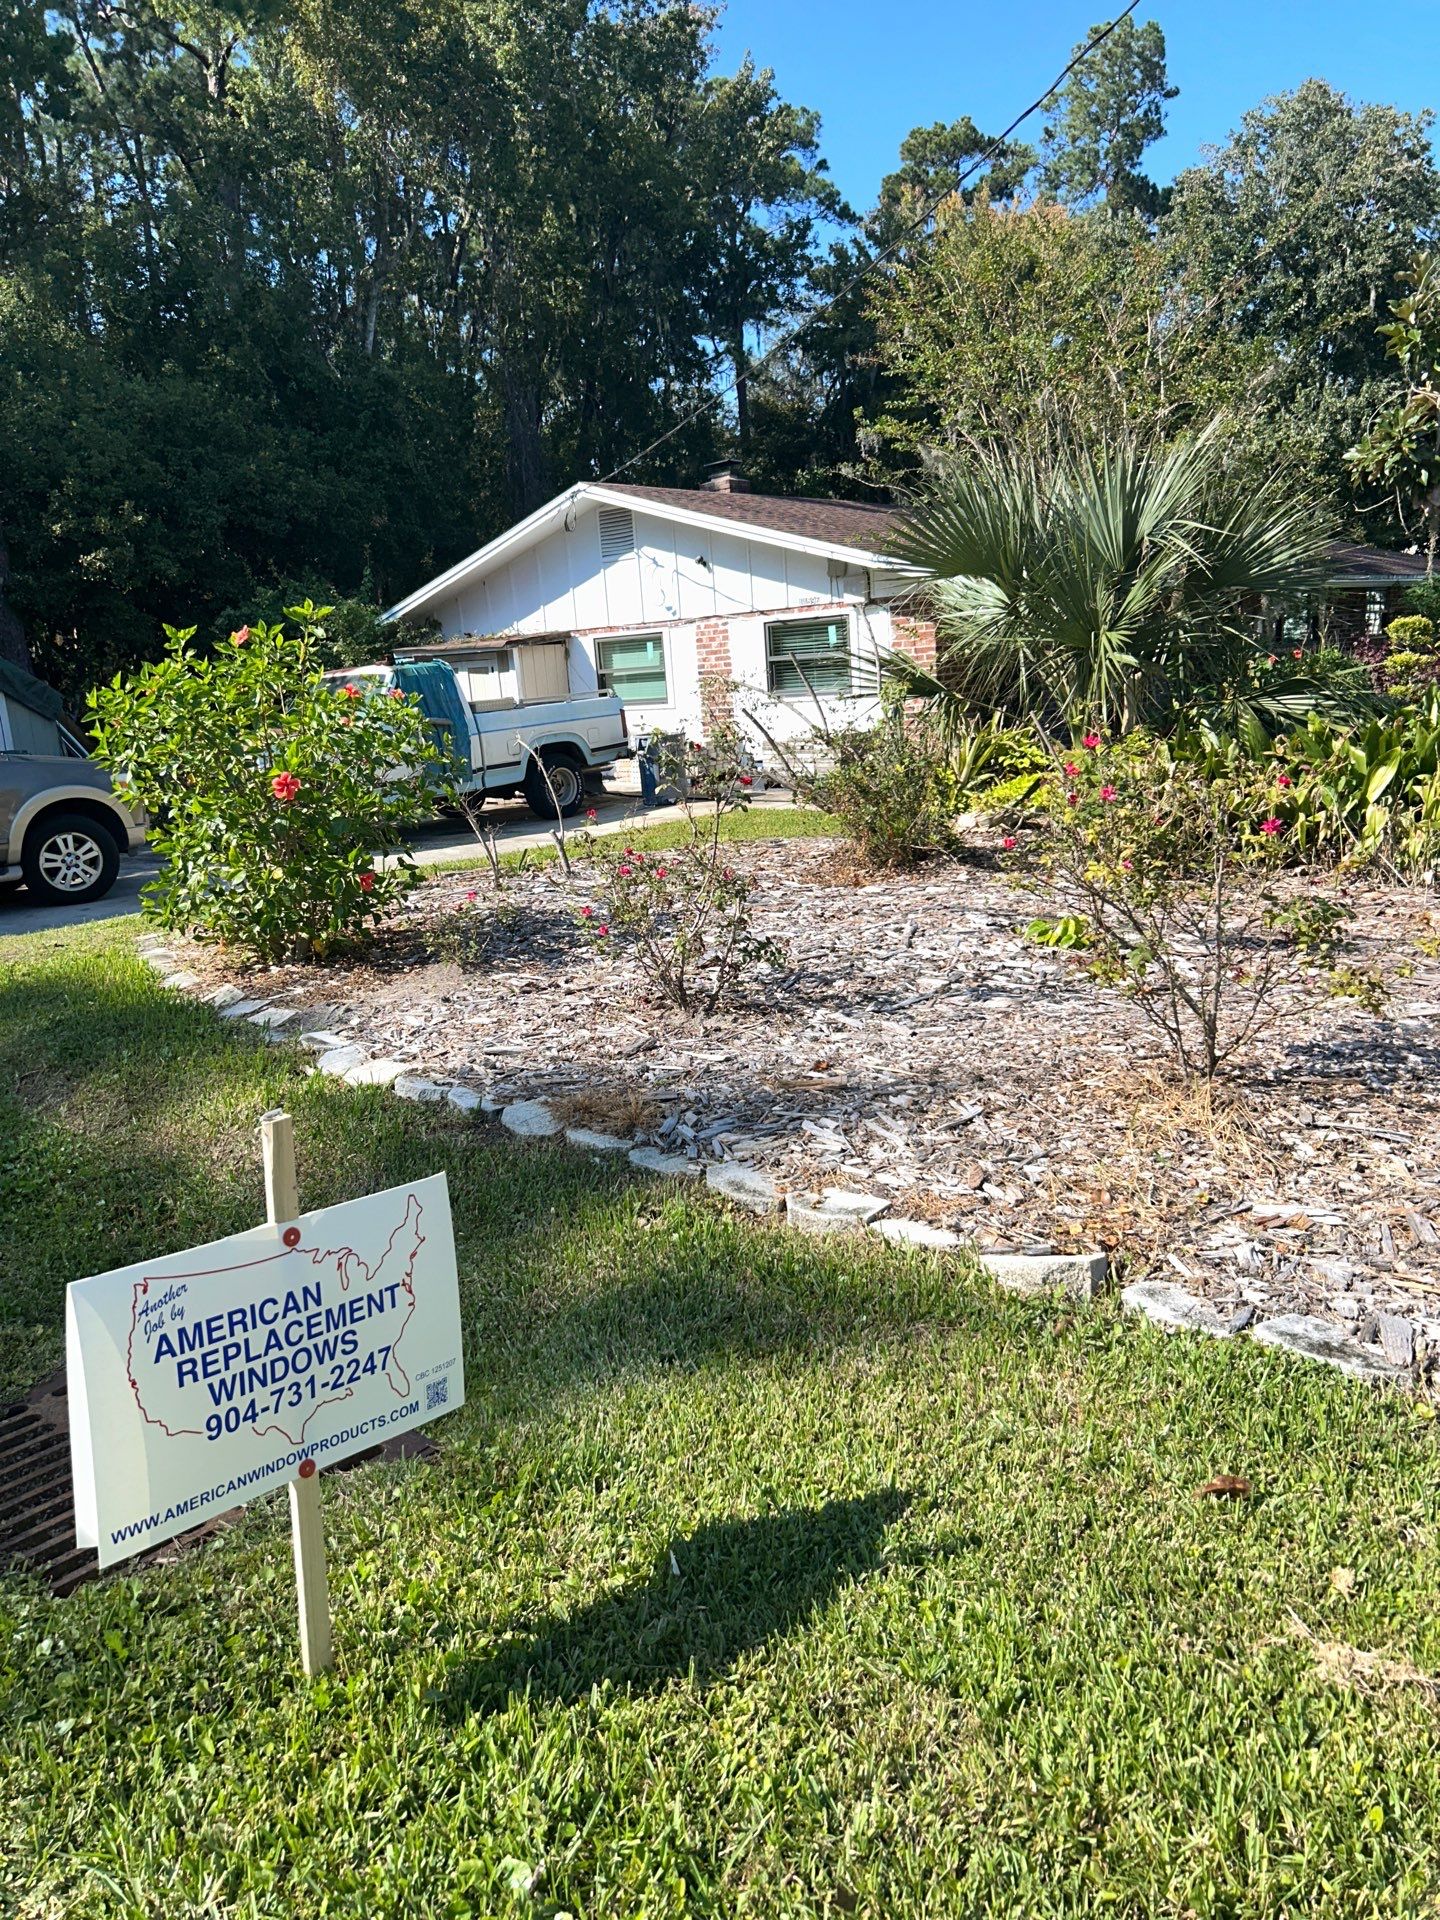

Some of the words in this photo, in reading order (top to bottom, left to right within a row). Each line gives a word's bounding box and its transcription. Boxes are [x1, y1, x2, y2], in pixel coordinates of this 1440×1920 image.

[138, 1282, 188, 1322] Another
[143, 1316, 166, 1343] Job
[170, 1304, 186, 1323] by
[153, 1281, 323, 1364] AMERICAN
[176, 1283, 402, 1388] REPLACEMENT
[205, 1346, 392, 1441] 904-731-2247
[208, 1329, 359, 1406] WINDOWS
[415, 1369, 430, 1381] CBC
[111, 1400, 420, 1545] WWW.AMERICANWINDOWPRODUCTS.COM
